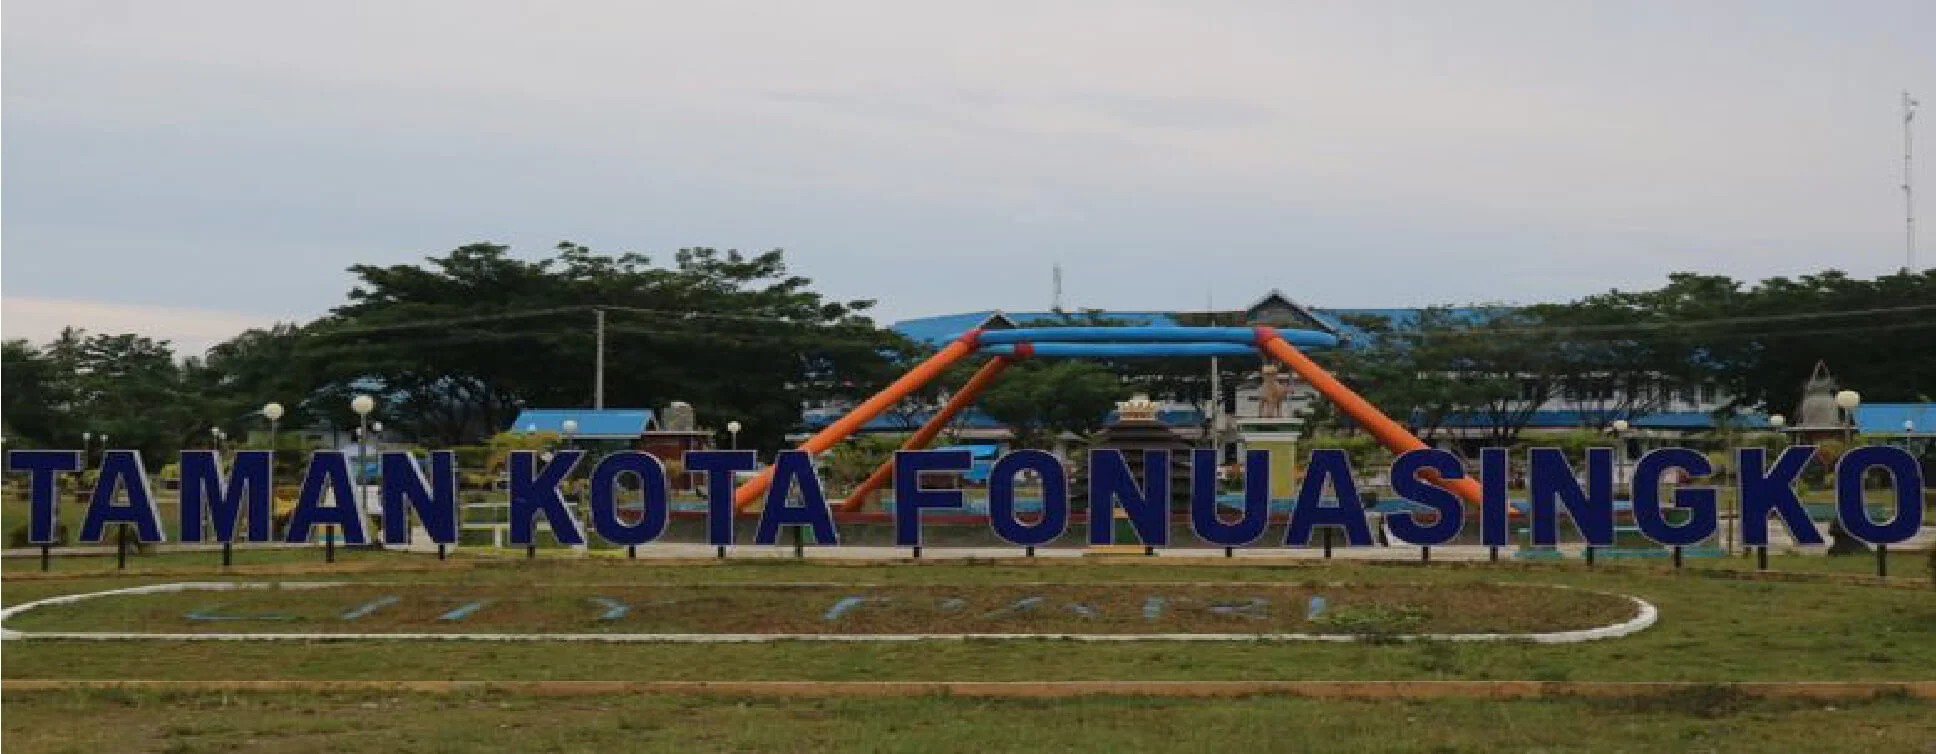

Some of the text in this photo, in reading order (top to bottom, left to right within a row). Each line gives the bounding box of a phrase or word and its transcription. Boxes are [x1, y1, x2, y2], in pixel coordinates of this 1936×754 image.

[8, 445, 1923, 548] TAMAN KOTA FONUASINGKO
